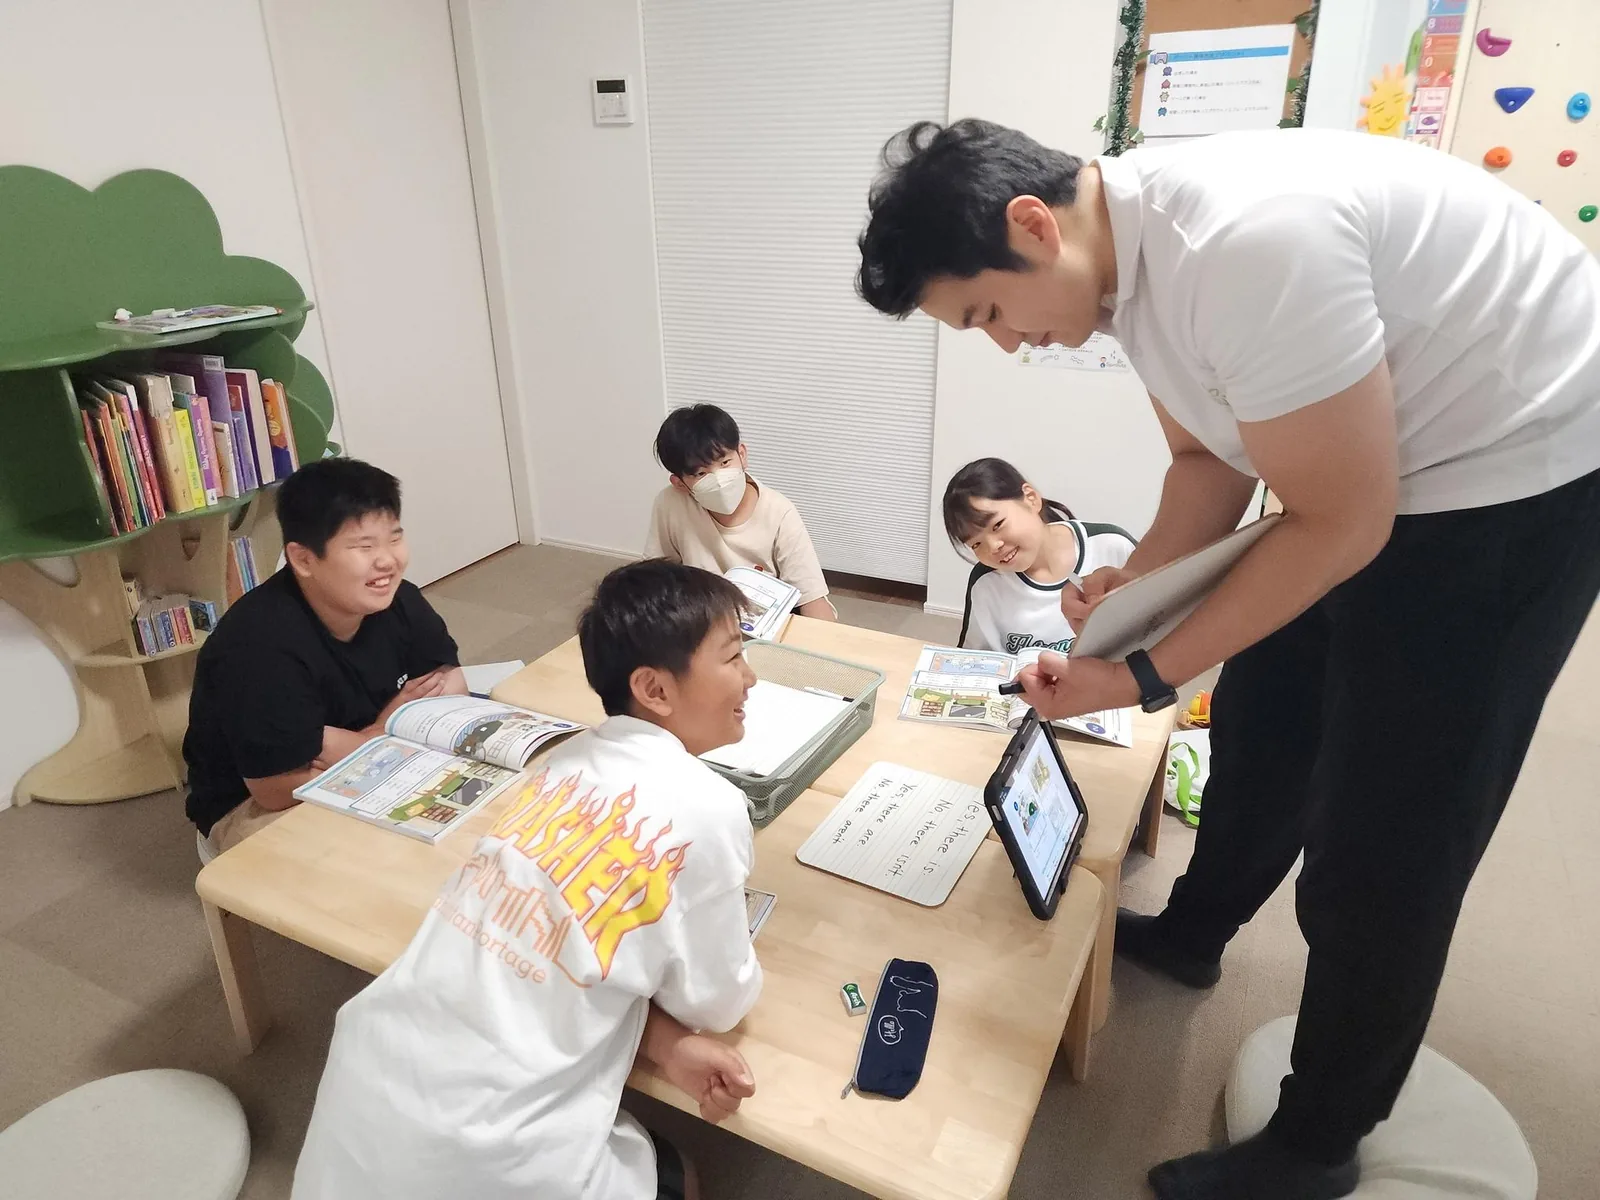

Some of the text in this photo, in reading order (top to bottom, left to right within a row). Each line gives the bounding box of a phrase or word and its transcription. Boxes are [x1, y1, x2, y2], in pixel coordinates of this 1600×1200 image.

[855, 792, 880, 813] there
[876, 803, 900, 824] there
[910, 820, 938, 846] there
[937, 826, 969, 854] there
[883, 1020, 897, 1039] Hello
